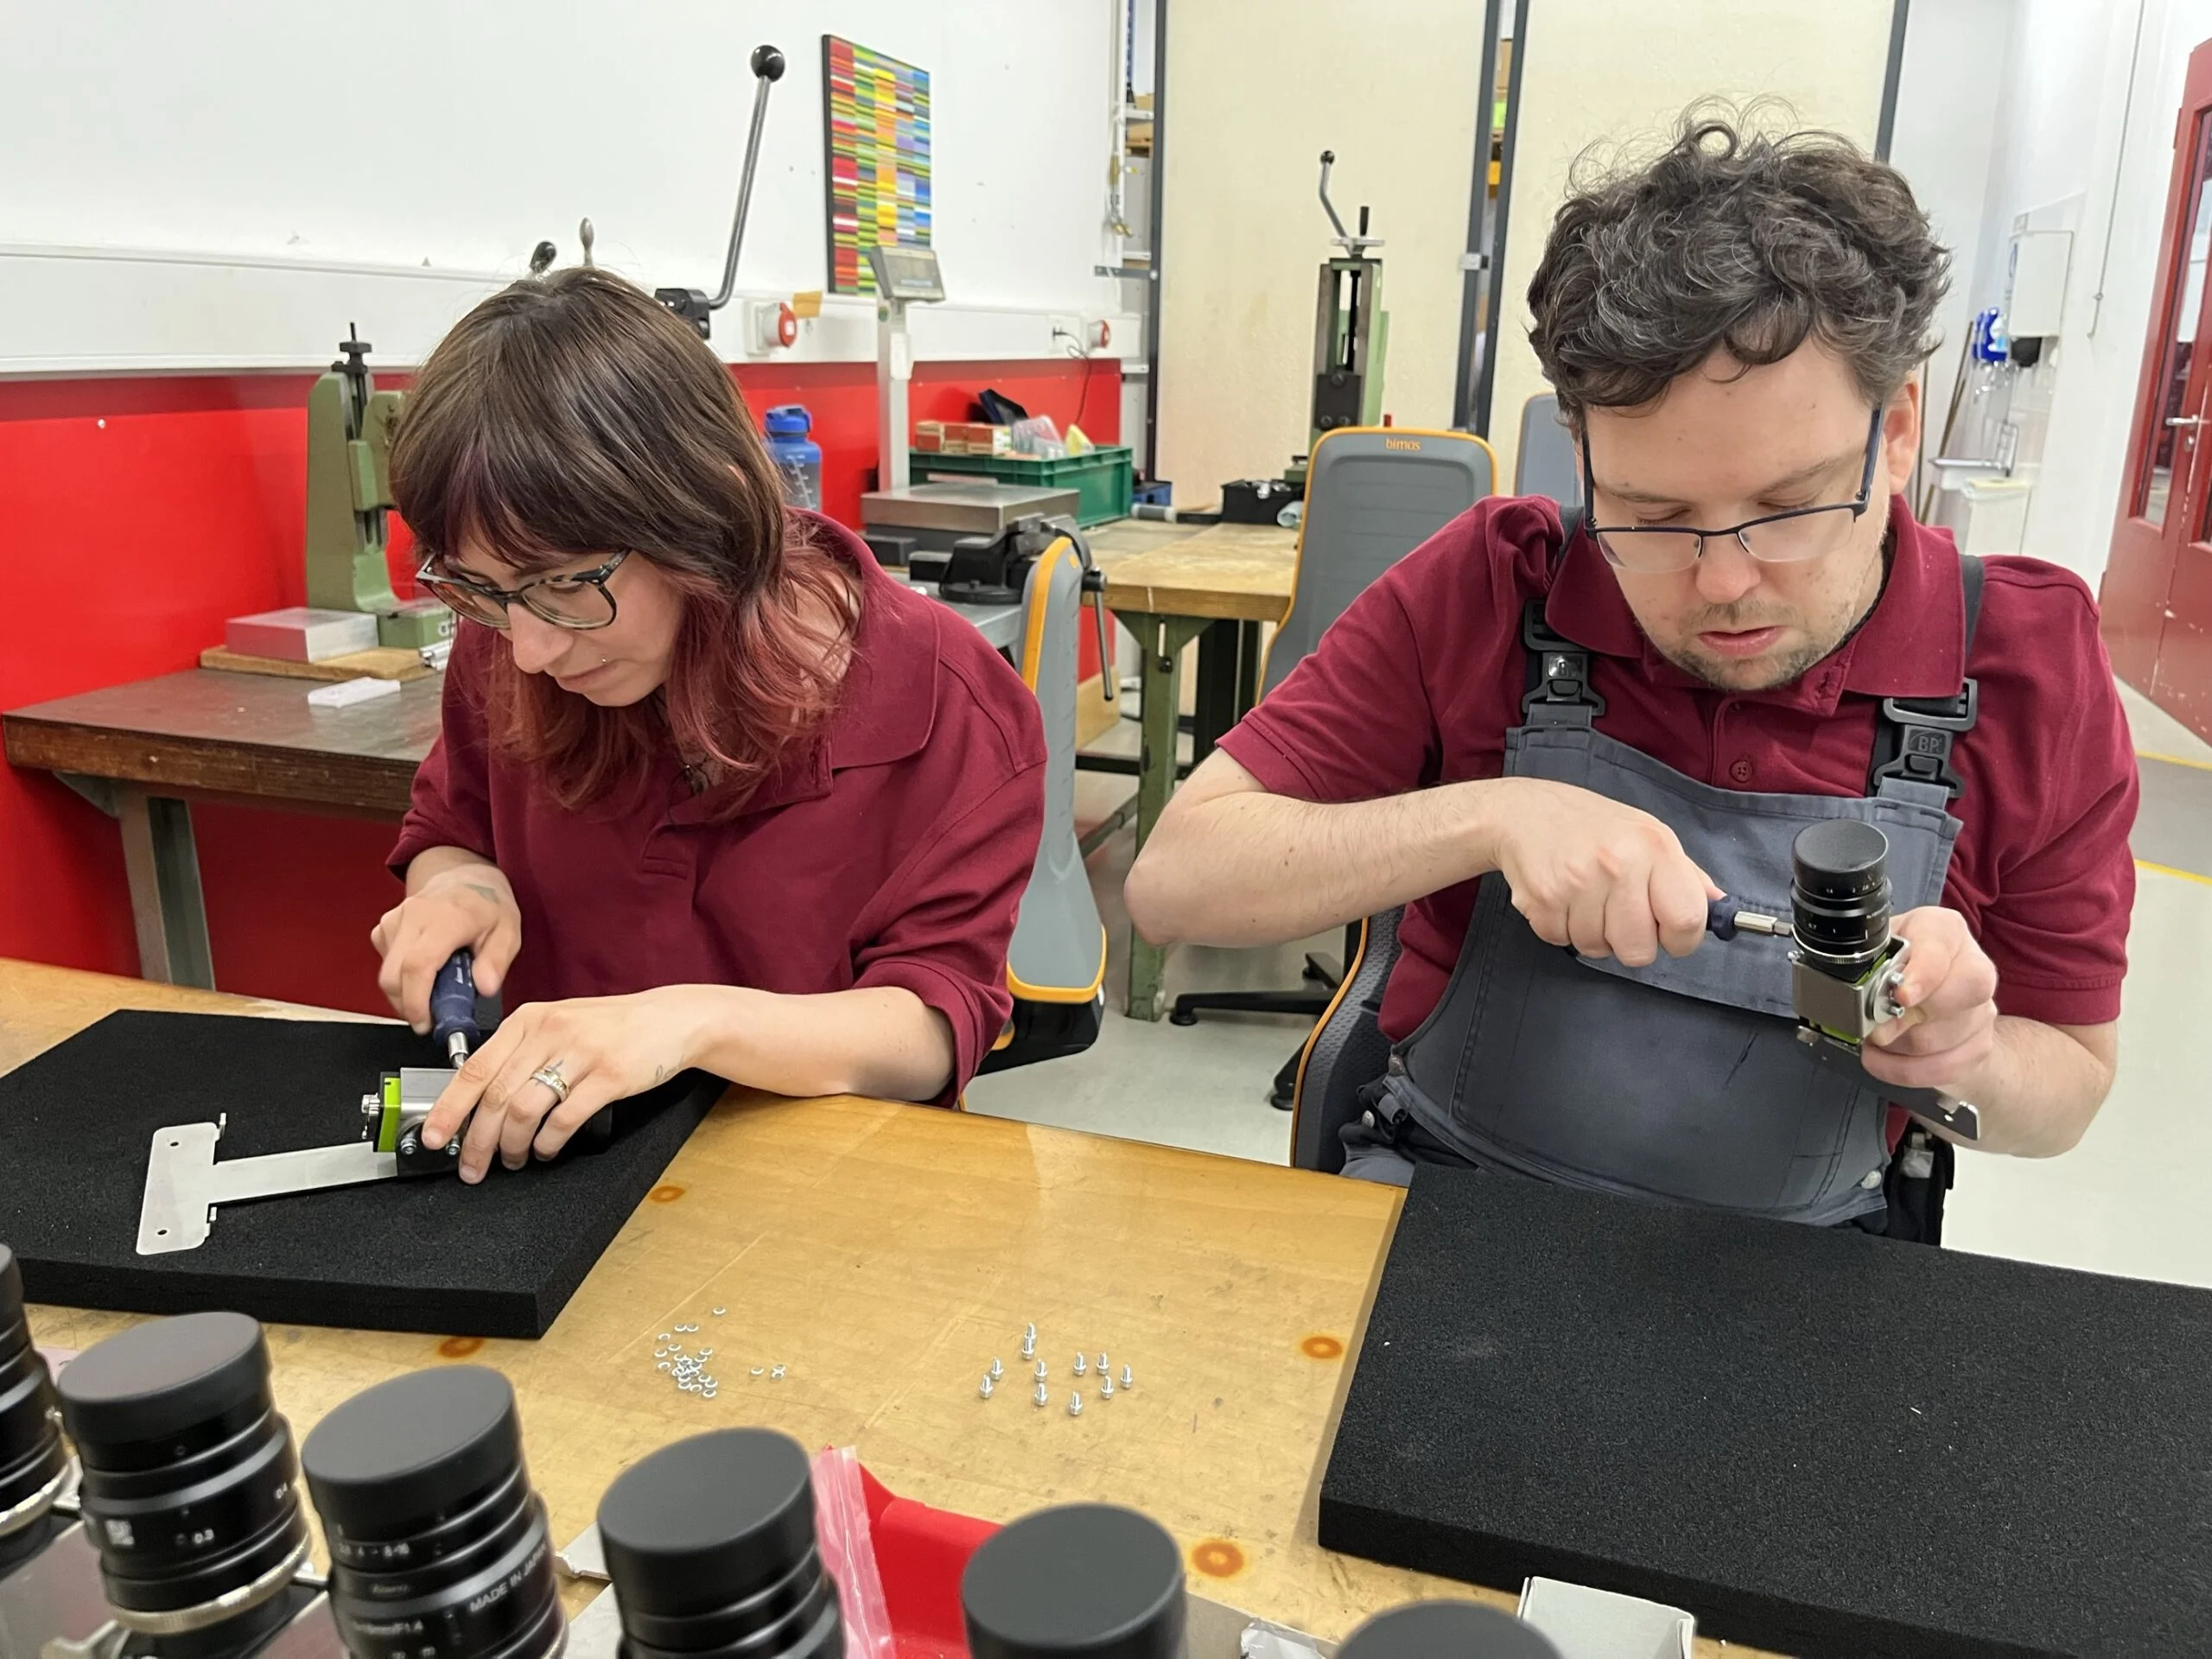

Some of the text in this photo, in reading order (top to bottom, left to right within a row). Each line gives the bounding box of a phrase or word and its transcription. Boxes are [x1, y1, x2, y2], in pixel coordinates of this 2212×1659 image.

[1385, 437, 1421, 450] bimos
[469, 1581, 509, 1613] MADE
[509, 1570, 523, 1588] IN
